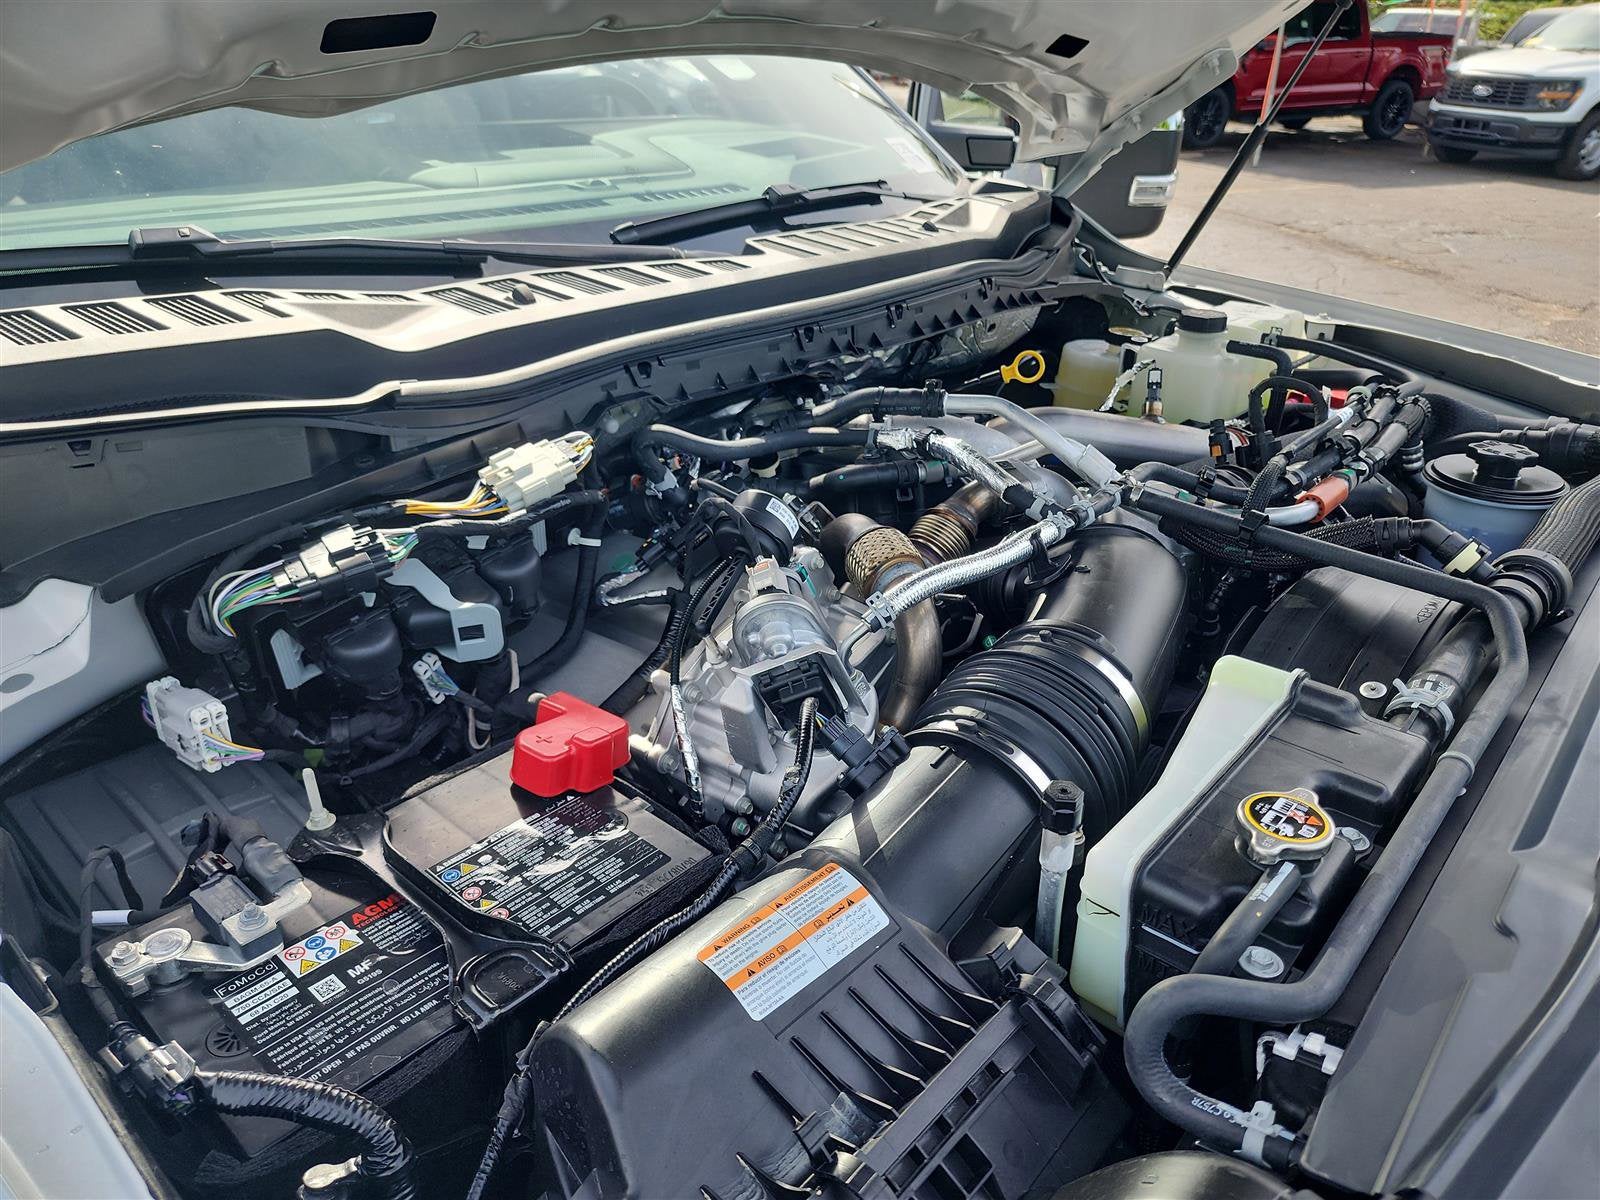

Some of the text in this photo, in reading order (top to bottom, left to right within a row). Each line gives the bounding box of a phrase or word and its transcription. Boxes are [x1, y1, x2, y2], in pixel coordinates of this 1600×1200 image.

[783, 871, 825, 901] AVERTISSEMENT
[352, 893, 398, 925] AGM
[356, 901, 403, 928] TECHNOLOG
[825, 903, 846, 922] تحذير
[721, 922, 750, 944] WARNING
[756, 951, 776, 967] AVISO
[218, 963, 273, 997] FoMoCo
[416, 976, 442, 995] الولايات
[393, 991, 417, 1007] المتحدة
[266, 1045, 285, 1056] Made
[289, 1033, 304, 1043] USA
[301, 1026, 316, 1035] with
[322, 1014, 335, 1023] and
[333, 1000, 359, 1016] imported
[319, 1057, 345, 1074] OPEN.
[344, 1049, 357, 1059] NE
[354, 1039, 371, 1052] PAS
[368, 1022, 399, 1043] OUVRIR.
[399, 1014, 411, 1025] NO
[409, 1009, 421, 1018] LA
[419, 997, 440, 1012] ABRA.
